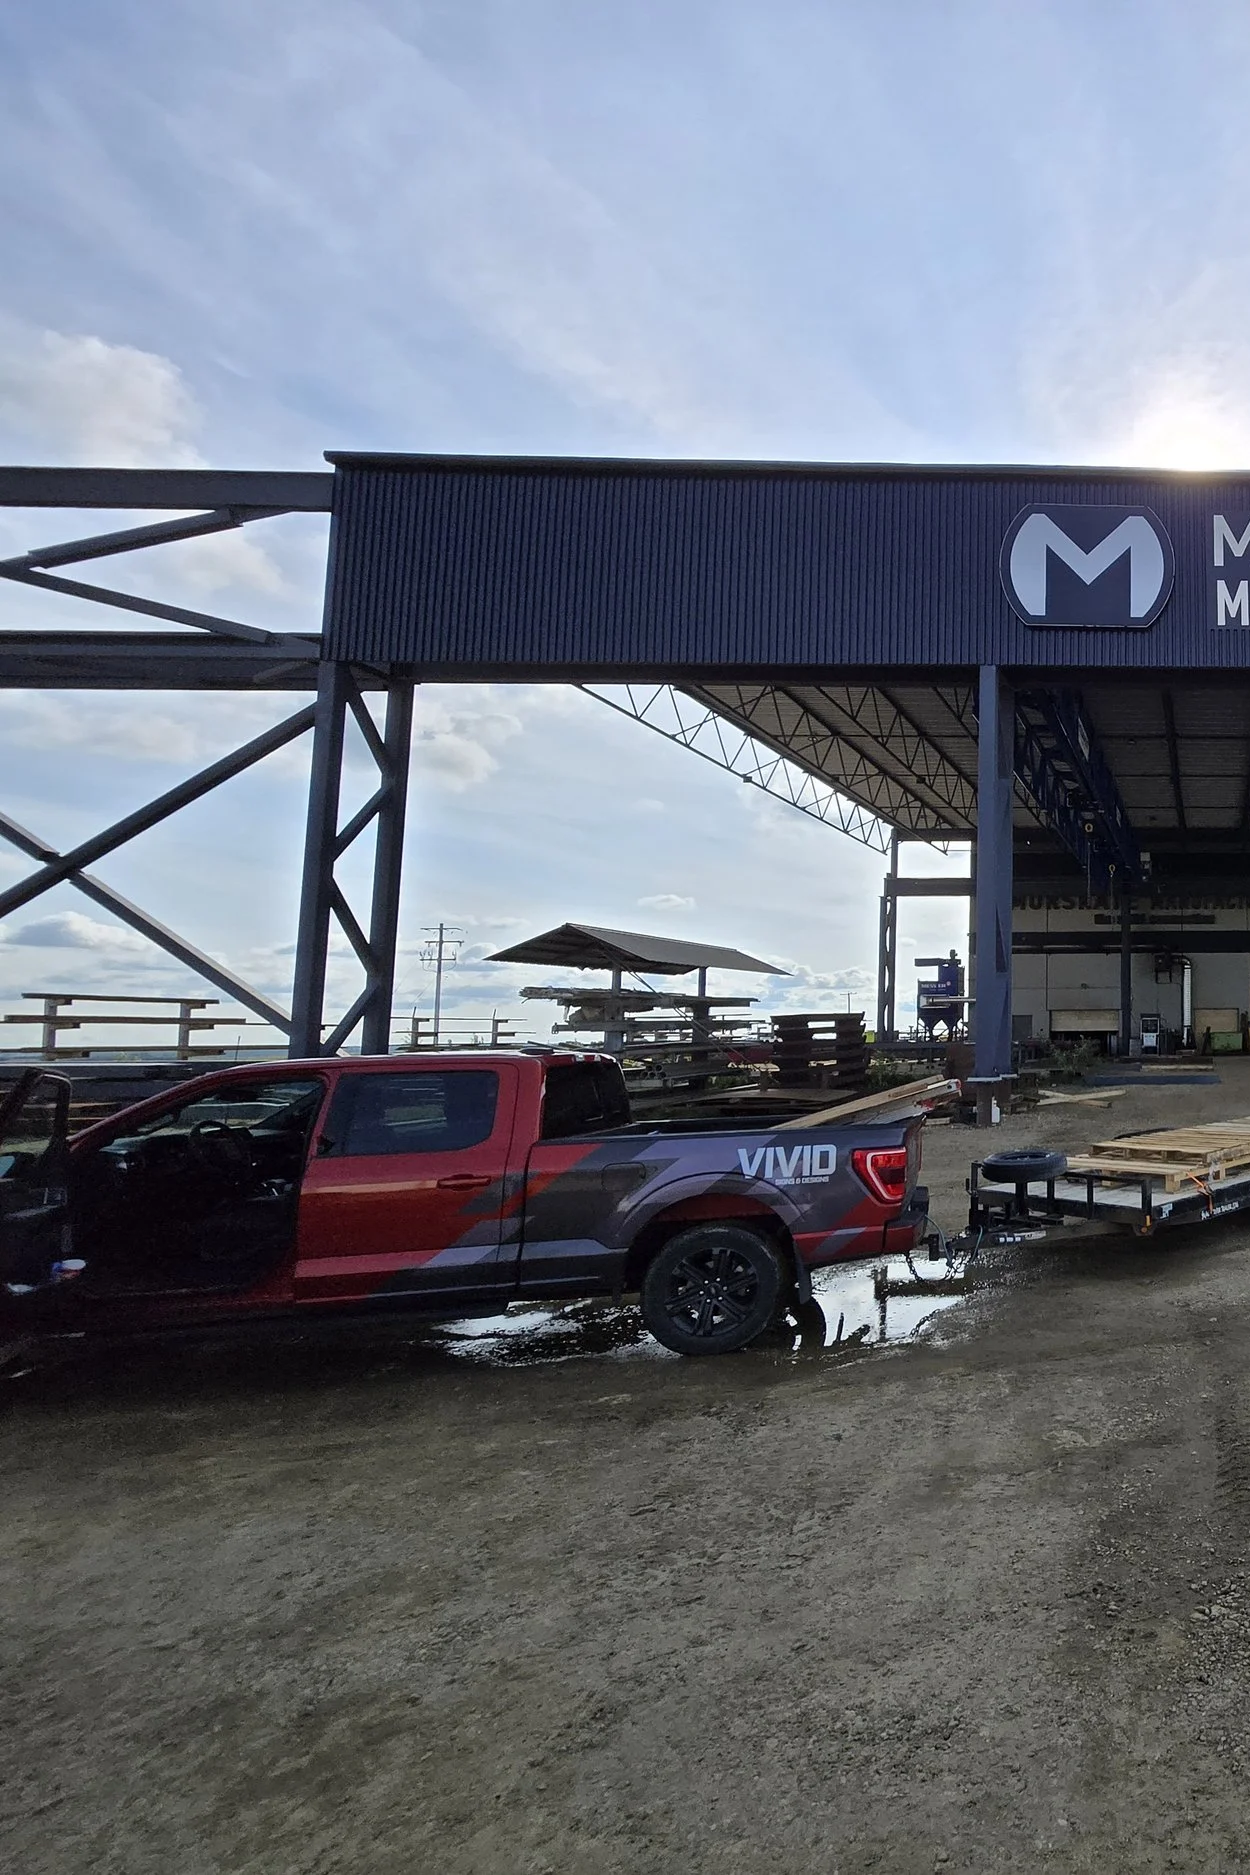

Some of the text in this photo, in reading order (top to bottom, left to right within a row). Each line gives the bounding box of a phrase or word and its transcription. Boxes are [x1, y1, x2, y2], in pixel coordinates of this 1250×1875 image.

[1010, 513, 1165, 618] M
[737, 1144, 837, 1180] VIVID
[775, 1178, 795, 1186] SIGNS
[801, 1176, 830, 1184] DESIGNS
